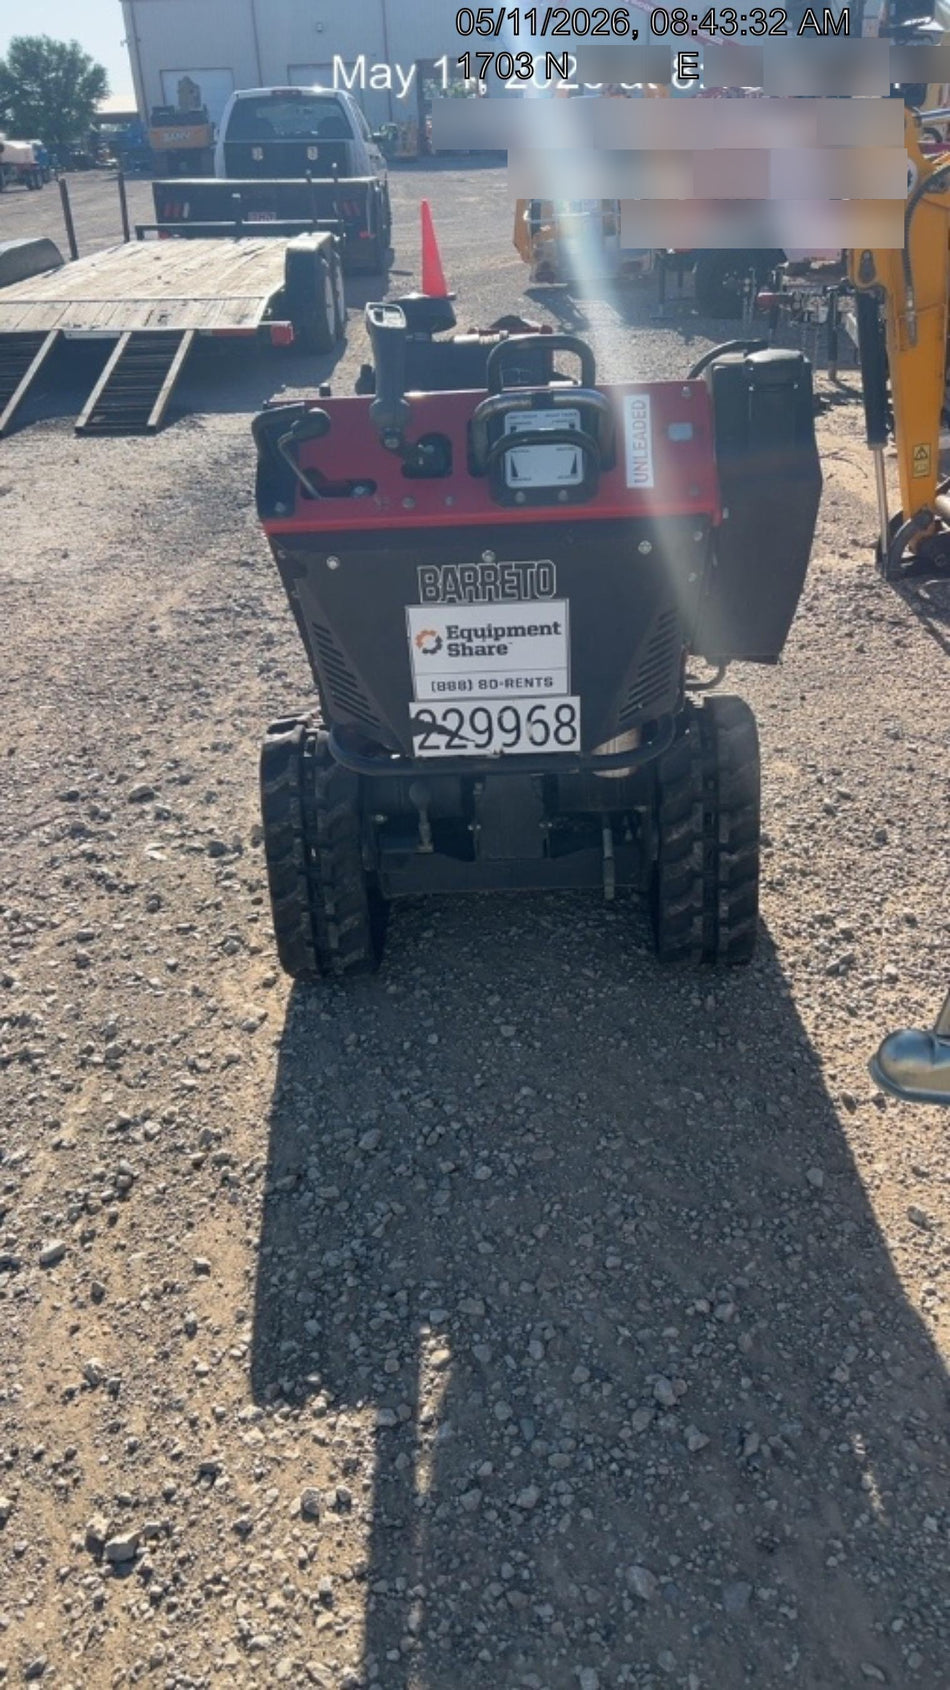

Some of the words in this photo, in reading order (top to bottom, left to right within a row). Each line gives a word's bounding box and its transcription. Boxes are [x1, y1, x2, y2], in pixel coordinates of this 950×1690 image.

[631, 400, 649, 484] UNLEADED
[417, 559, 557, 604] BARRETO
[446, 621, 562, 642] Equipment
[447, 642, 509, 658] Share
[431, 678, 474, 693] (888)
[413, 703, 578, 751] 229968
